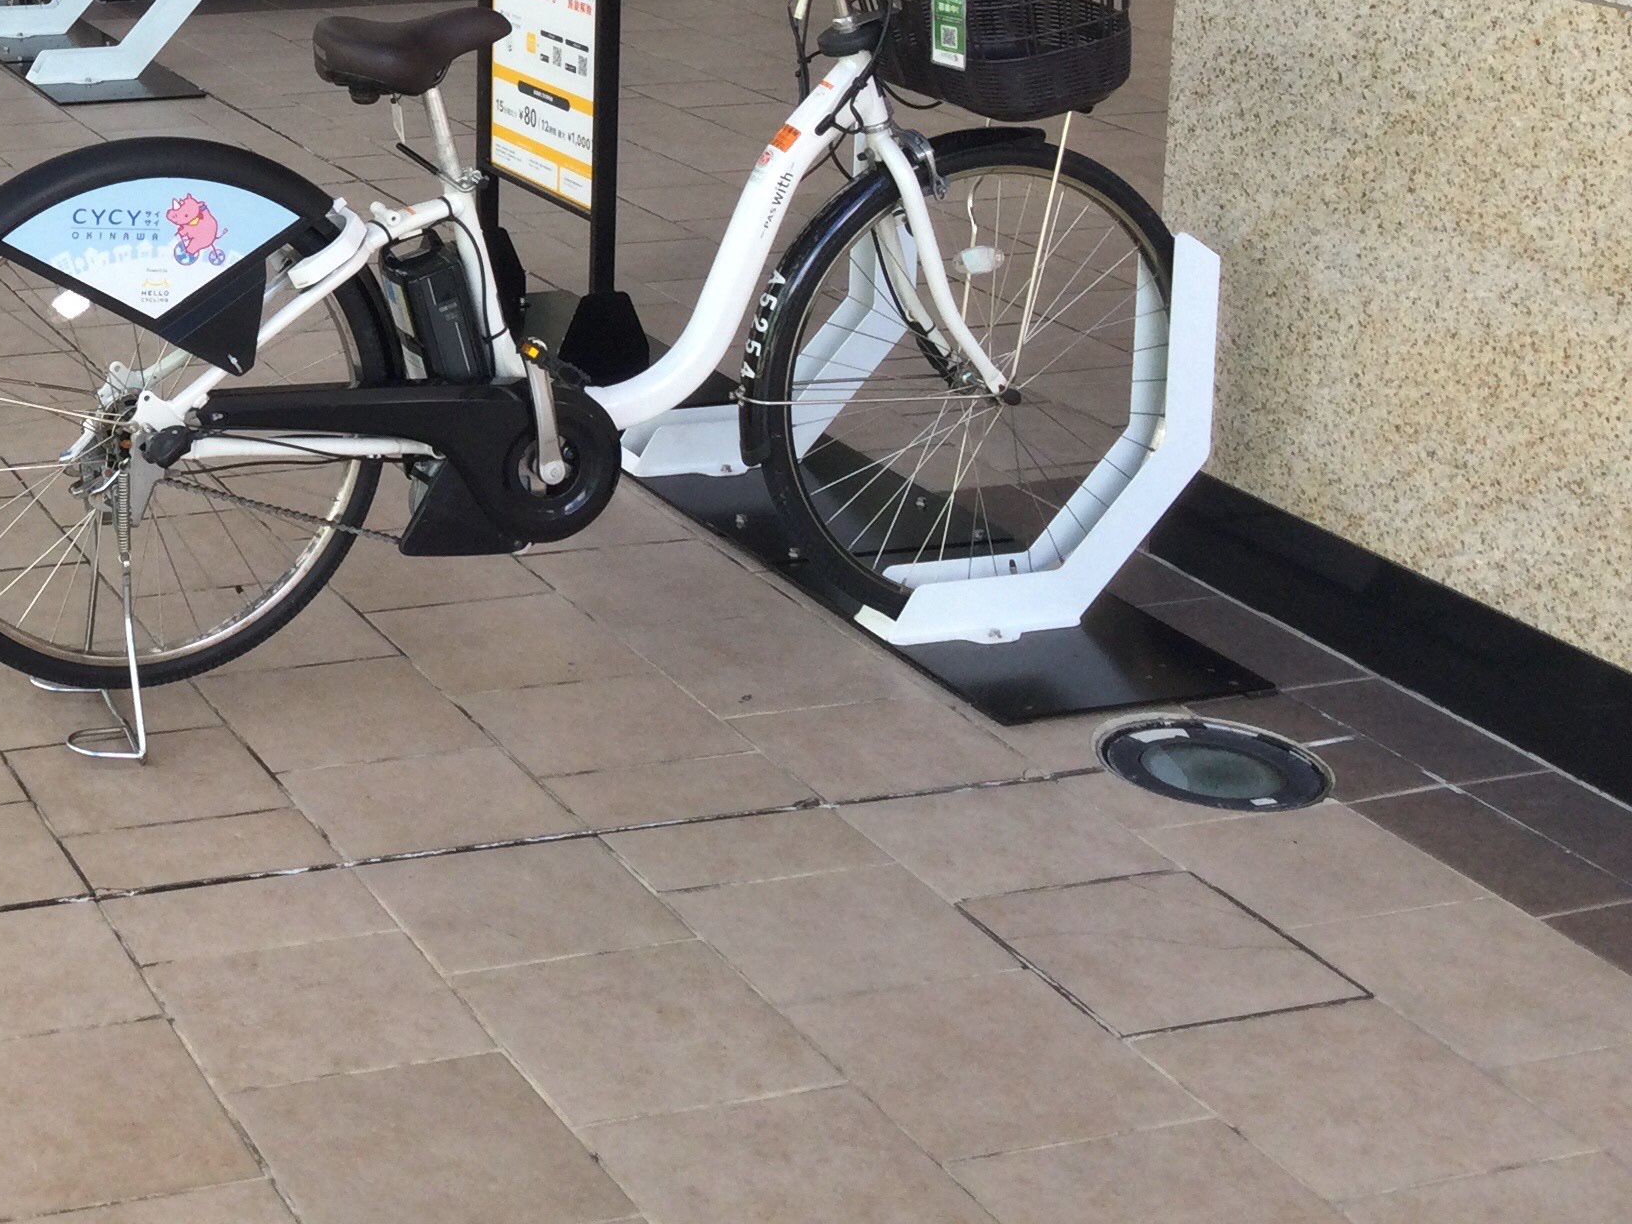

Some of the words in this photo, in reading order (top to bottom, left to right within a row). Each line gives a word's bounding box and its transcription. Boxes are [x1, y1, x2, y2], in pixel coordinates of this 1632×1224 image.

[772, 172, 794, 205] with
[72, 208, 142, 227] CYCY
[71, 231, 159, 241] OKINAWA
[741, 269, 786, 379] A5254
